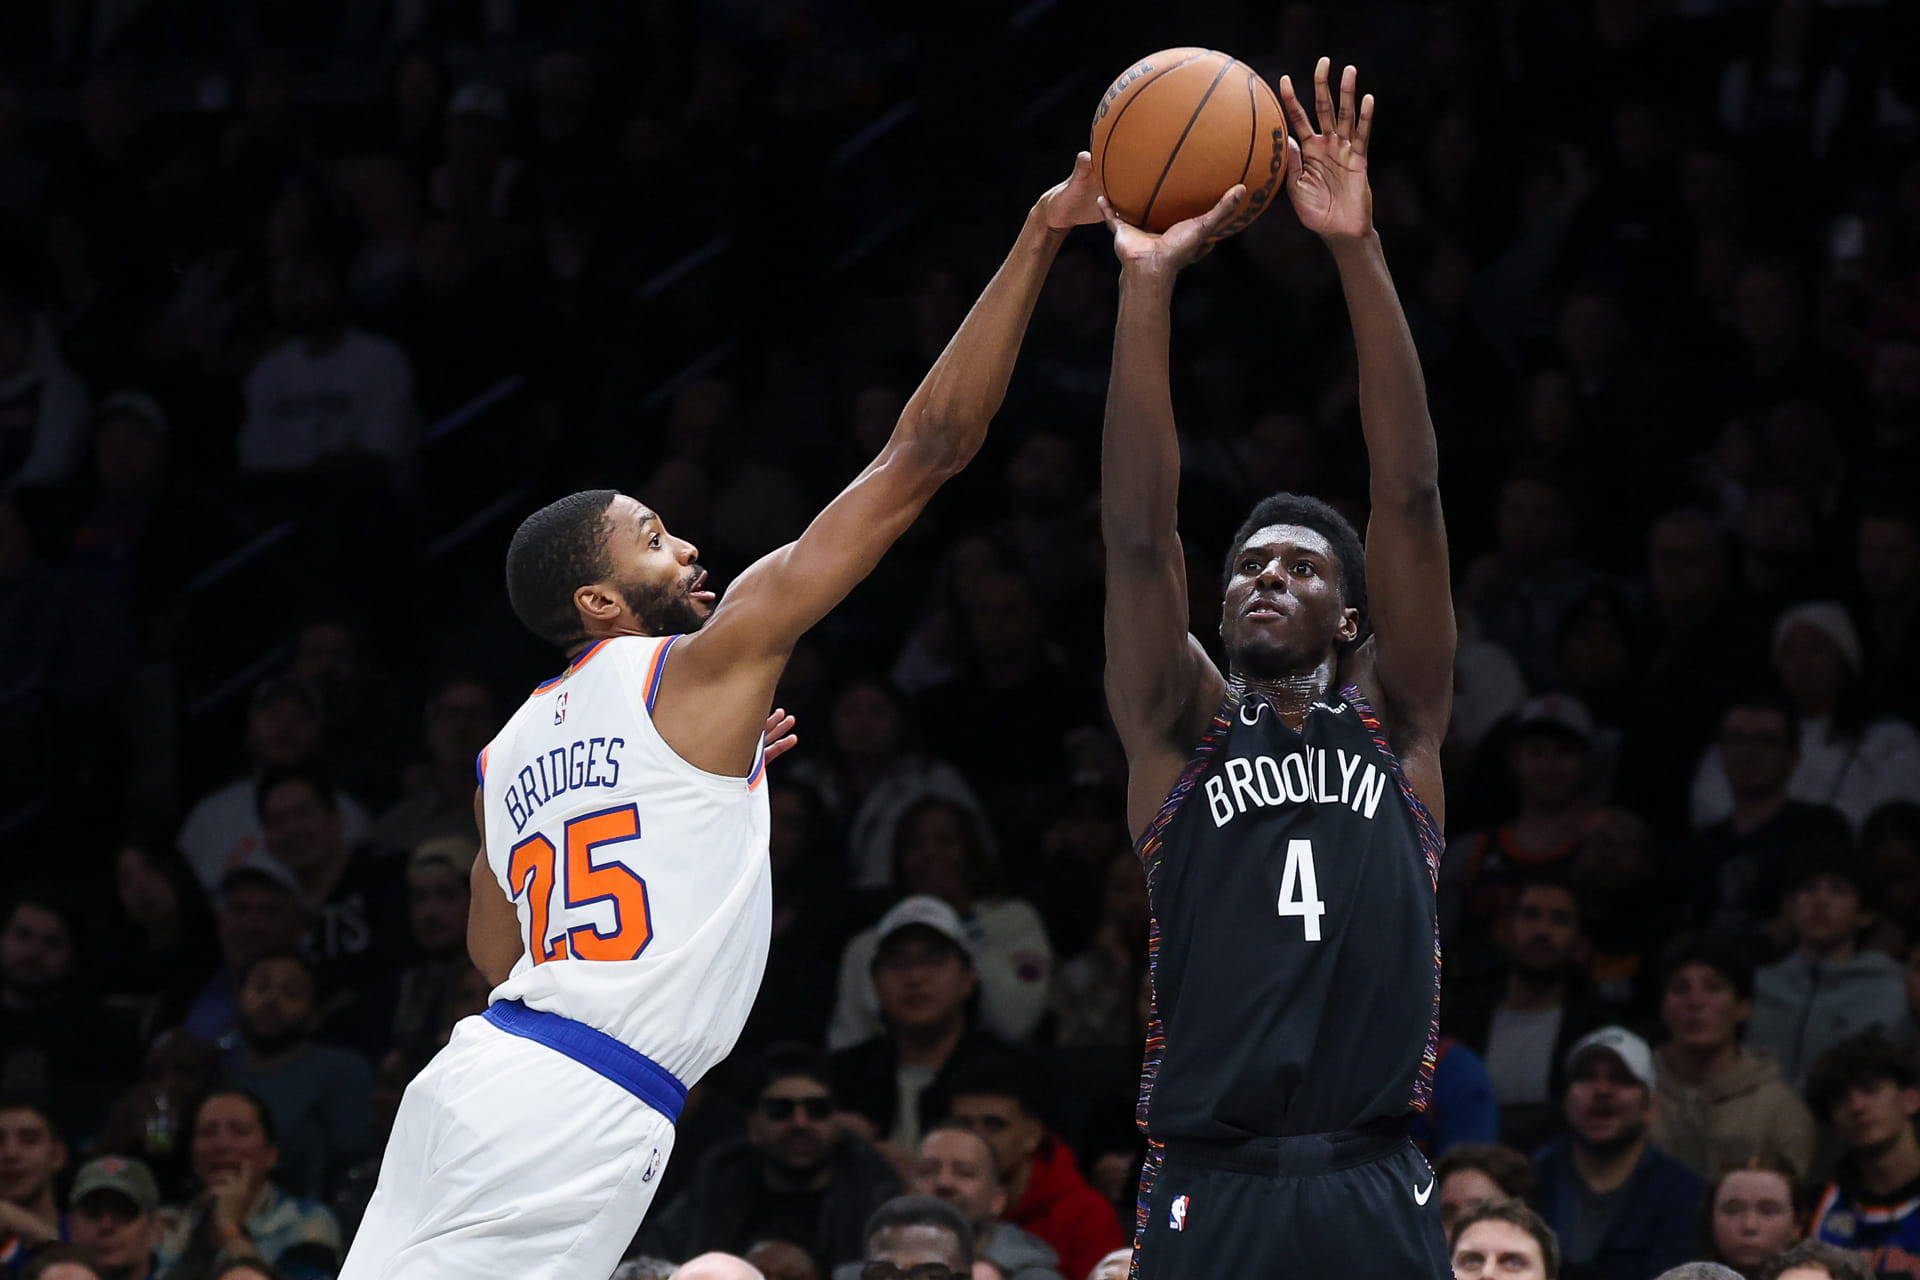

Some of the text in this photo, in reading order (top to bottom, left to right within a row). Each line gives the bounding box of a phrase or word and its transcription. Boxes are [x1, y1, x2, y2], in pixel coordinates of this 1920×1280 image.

[504, 737, 624, 834] BRIDGES
[507, 802, 653, 967] 25
[1278, 839, 1325, 941] 4
